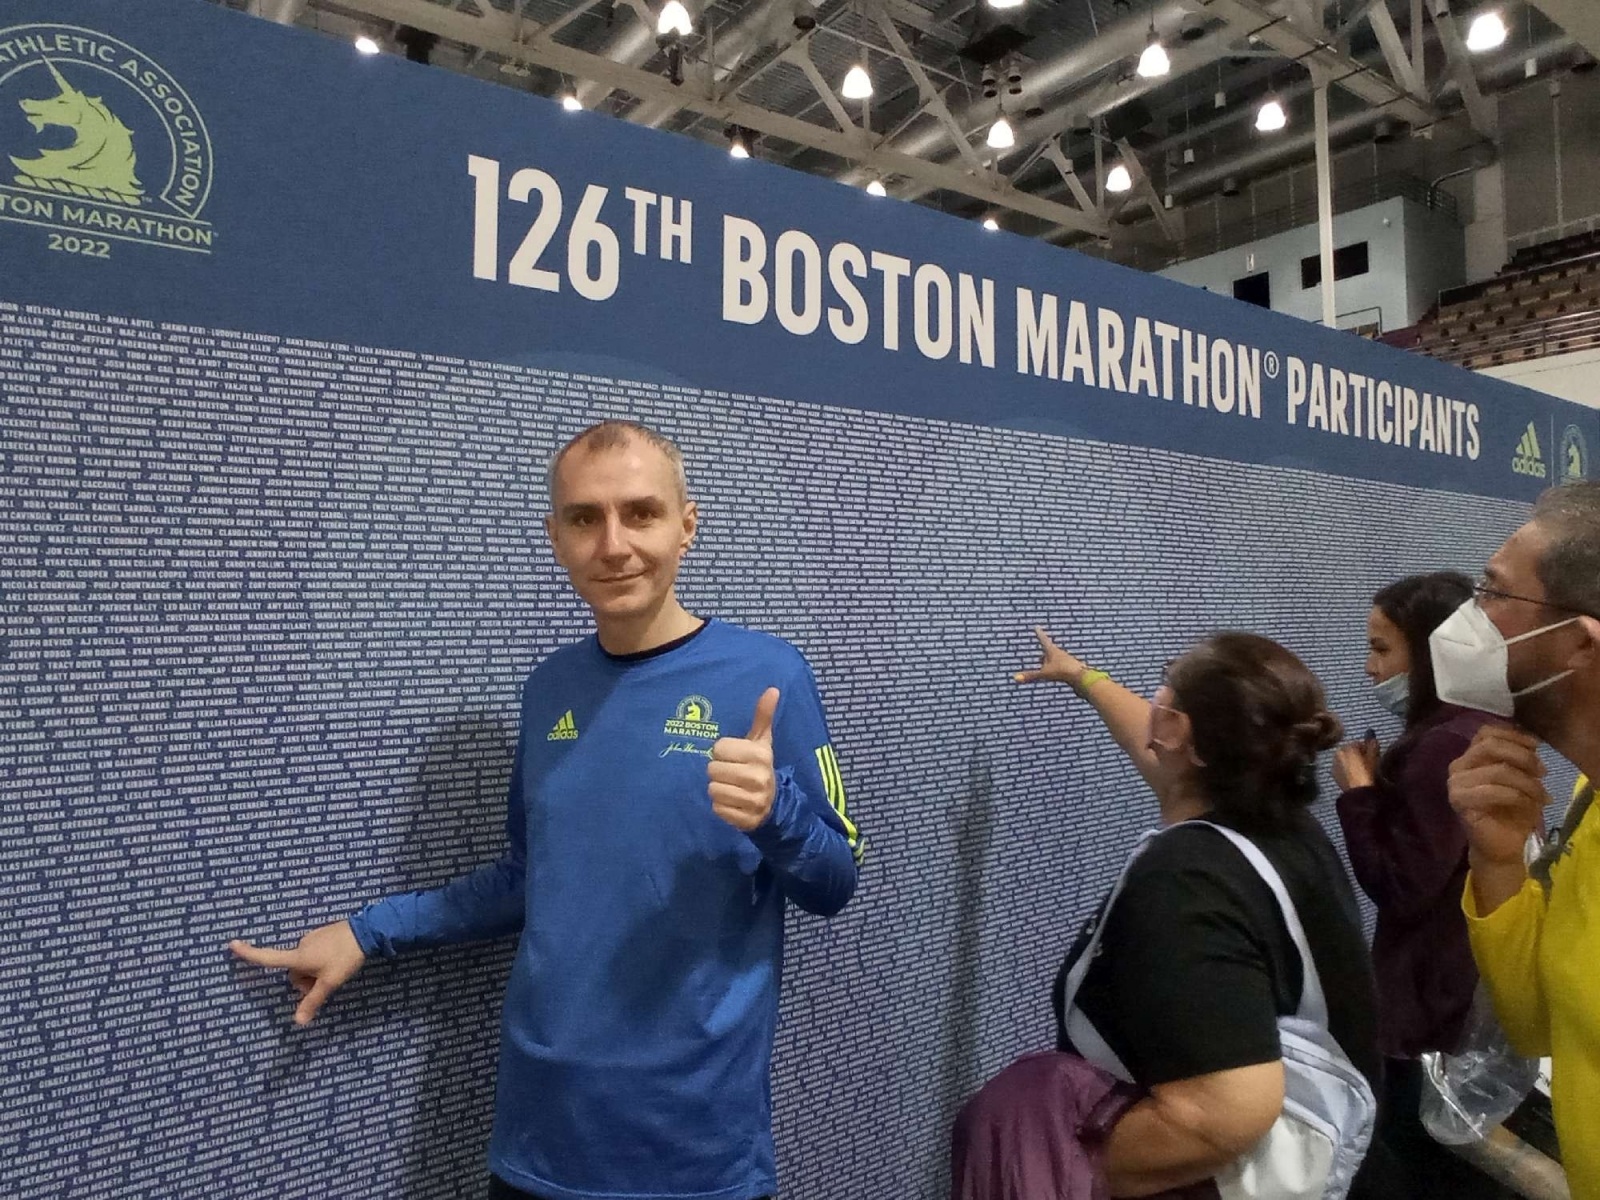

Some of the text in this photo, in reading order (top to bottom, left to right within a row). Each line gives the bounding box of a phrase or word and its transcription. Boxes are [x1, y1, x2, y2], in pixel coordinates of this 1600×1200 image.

[120, 59, 201, 206] ASSOCIATION
[63, 204, 211, 246] MARATHON
[48, 233, 110, 259] 2022
[468, 154, 692, 300] 126TH
[723, 214, 995, 368] BOSTON
[1287, 356, 1481, 461] PARTICIPANTS
[1512, 457, 1545, 478] adidas
[547, 730, 578, 741] adidas
[664, 727, 718, 739] MARATHON
[665, 719, 719, 731] 2022 BOSTON
